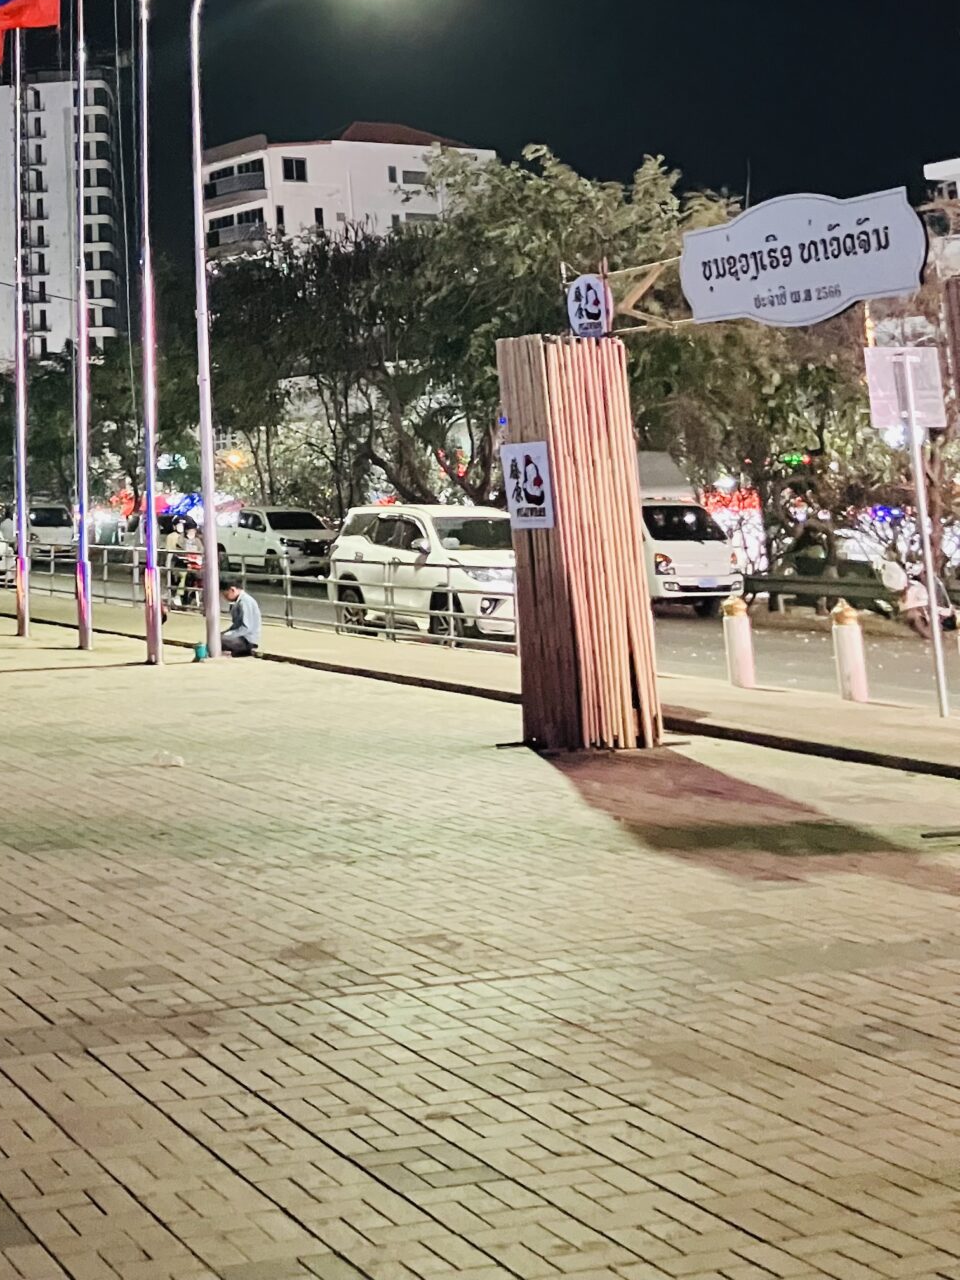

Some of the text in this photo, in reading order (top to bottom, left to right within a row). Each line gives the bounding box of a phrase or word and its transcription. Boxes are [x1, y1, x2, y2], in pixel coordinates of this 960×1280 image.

[798, 217, 890, 264] ທ່າວັດຈັນ
[815, 283, 842, 301] 2566
